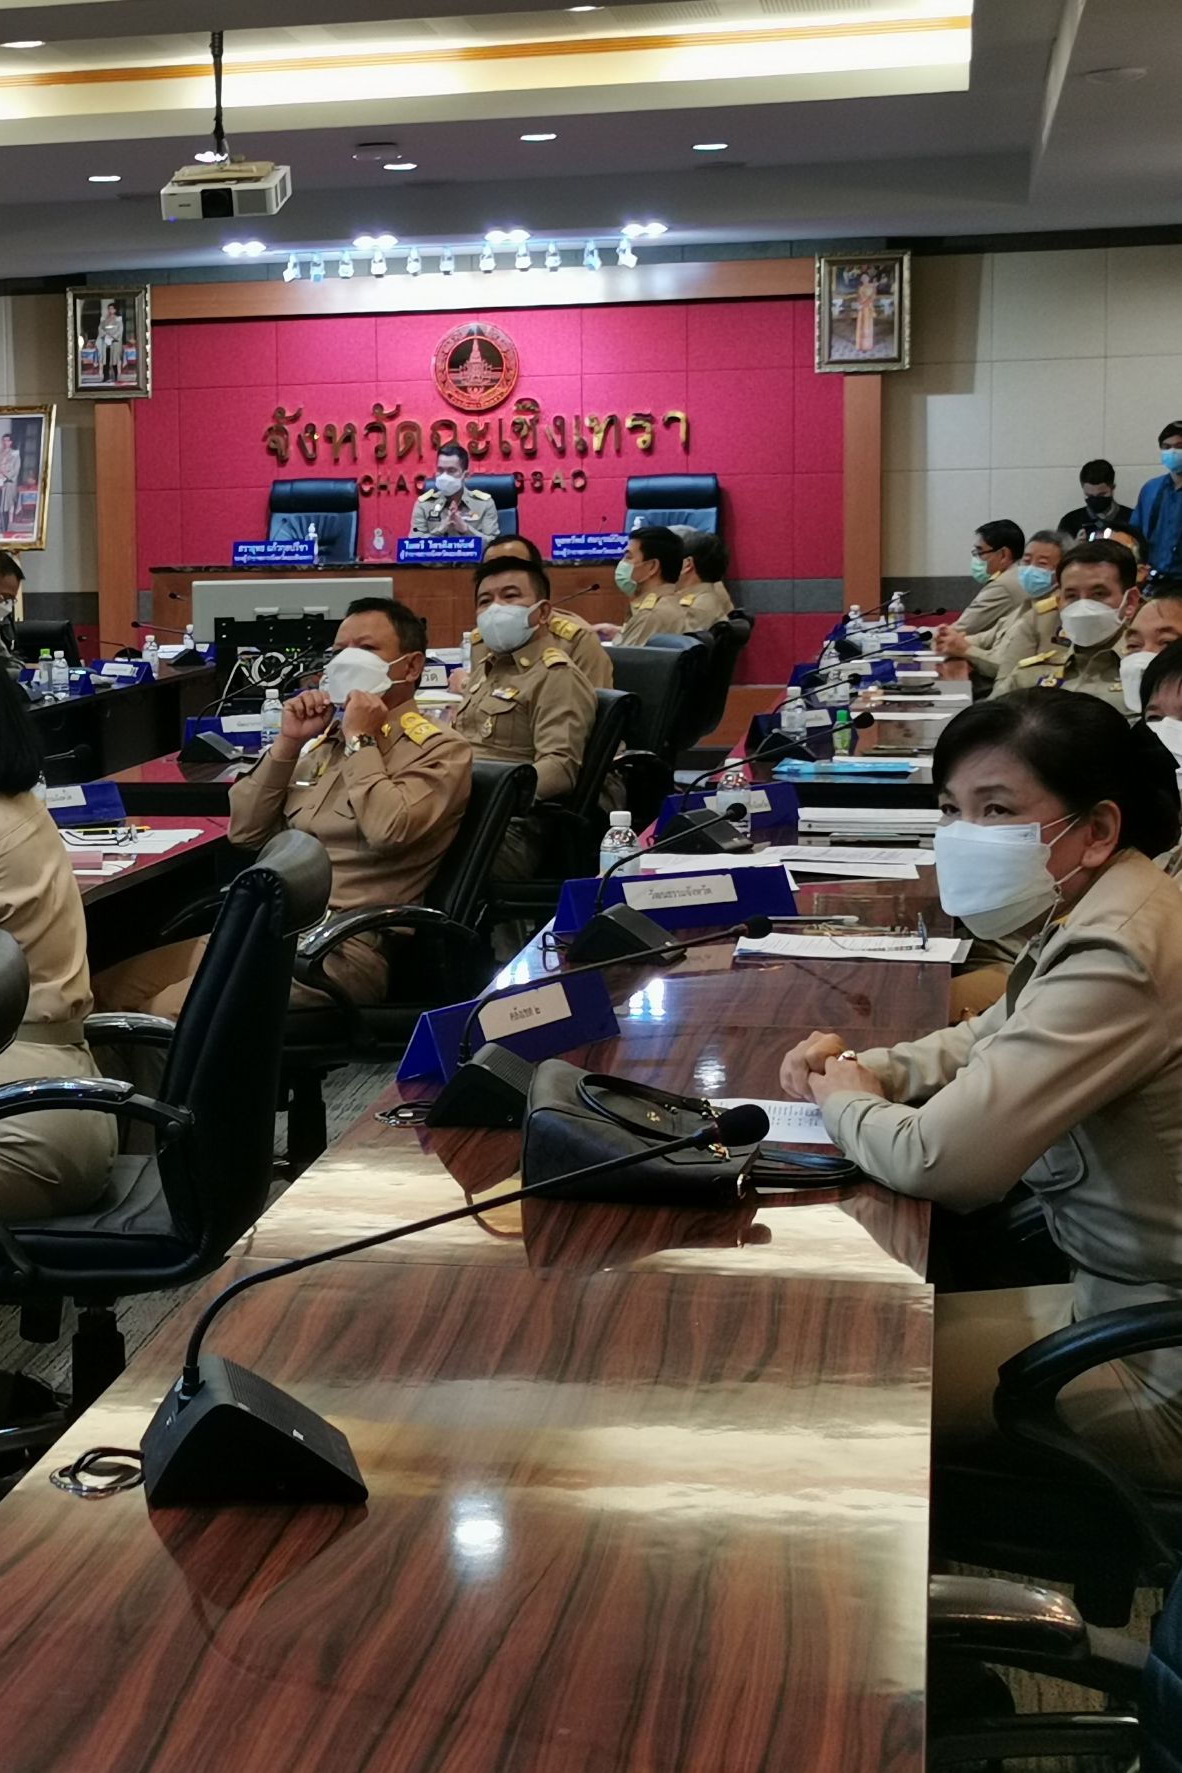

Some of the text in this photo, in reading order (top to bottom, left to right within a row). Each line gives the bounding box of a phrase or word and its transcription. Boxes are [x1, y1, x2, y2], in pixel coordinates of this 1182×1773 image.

[264, 398, 690, 463] จังหวัดฉะเชิงเทรา
[359, 469, 588, 497] CHACGSAO
